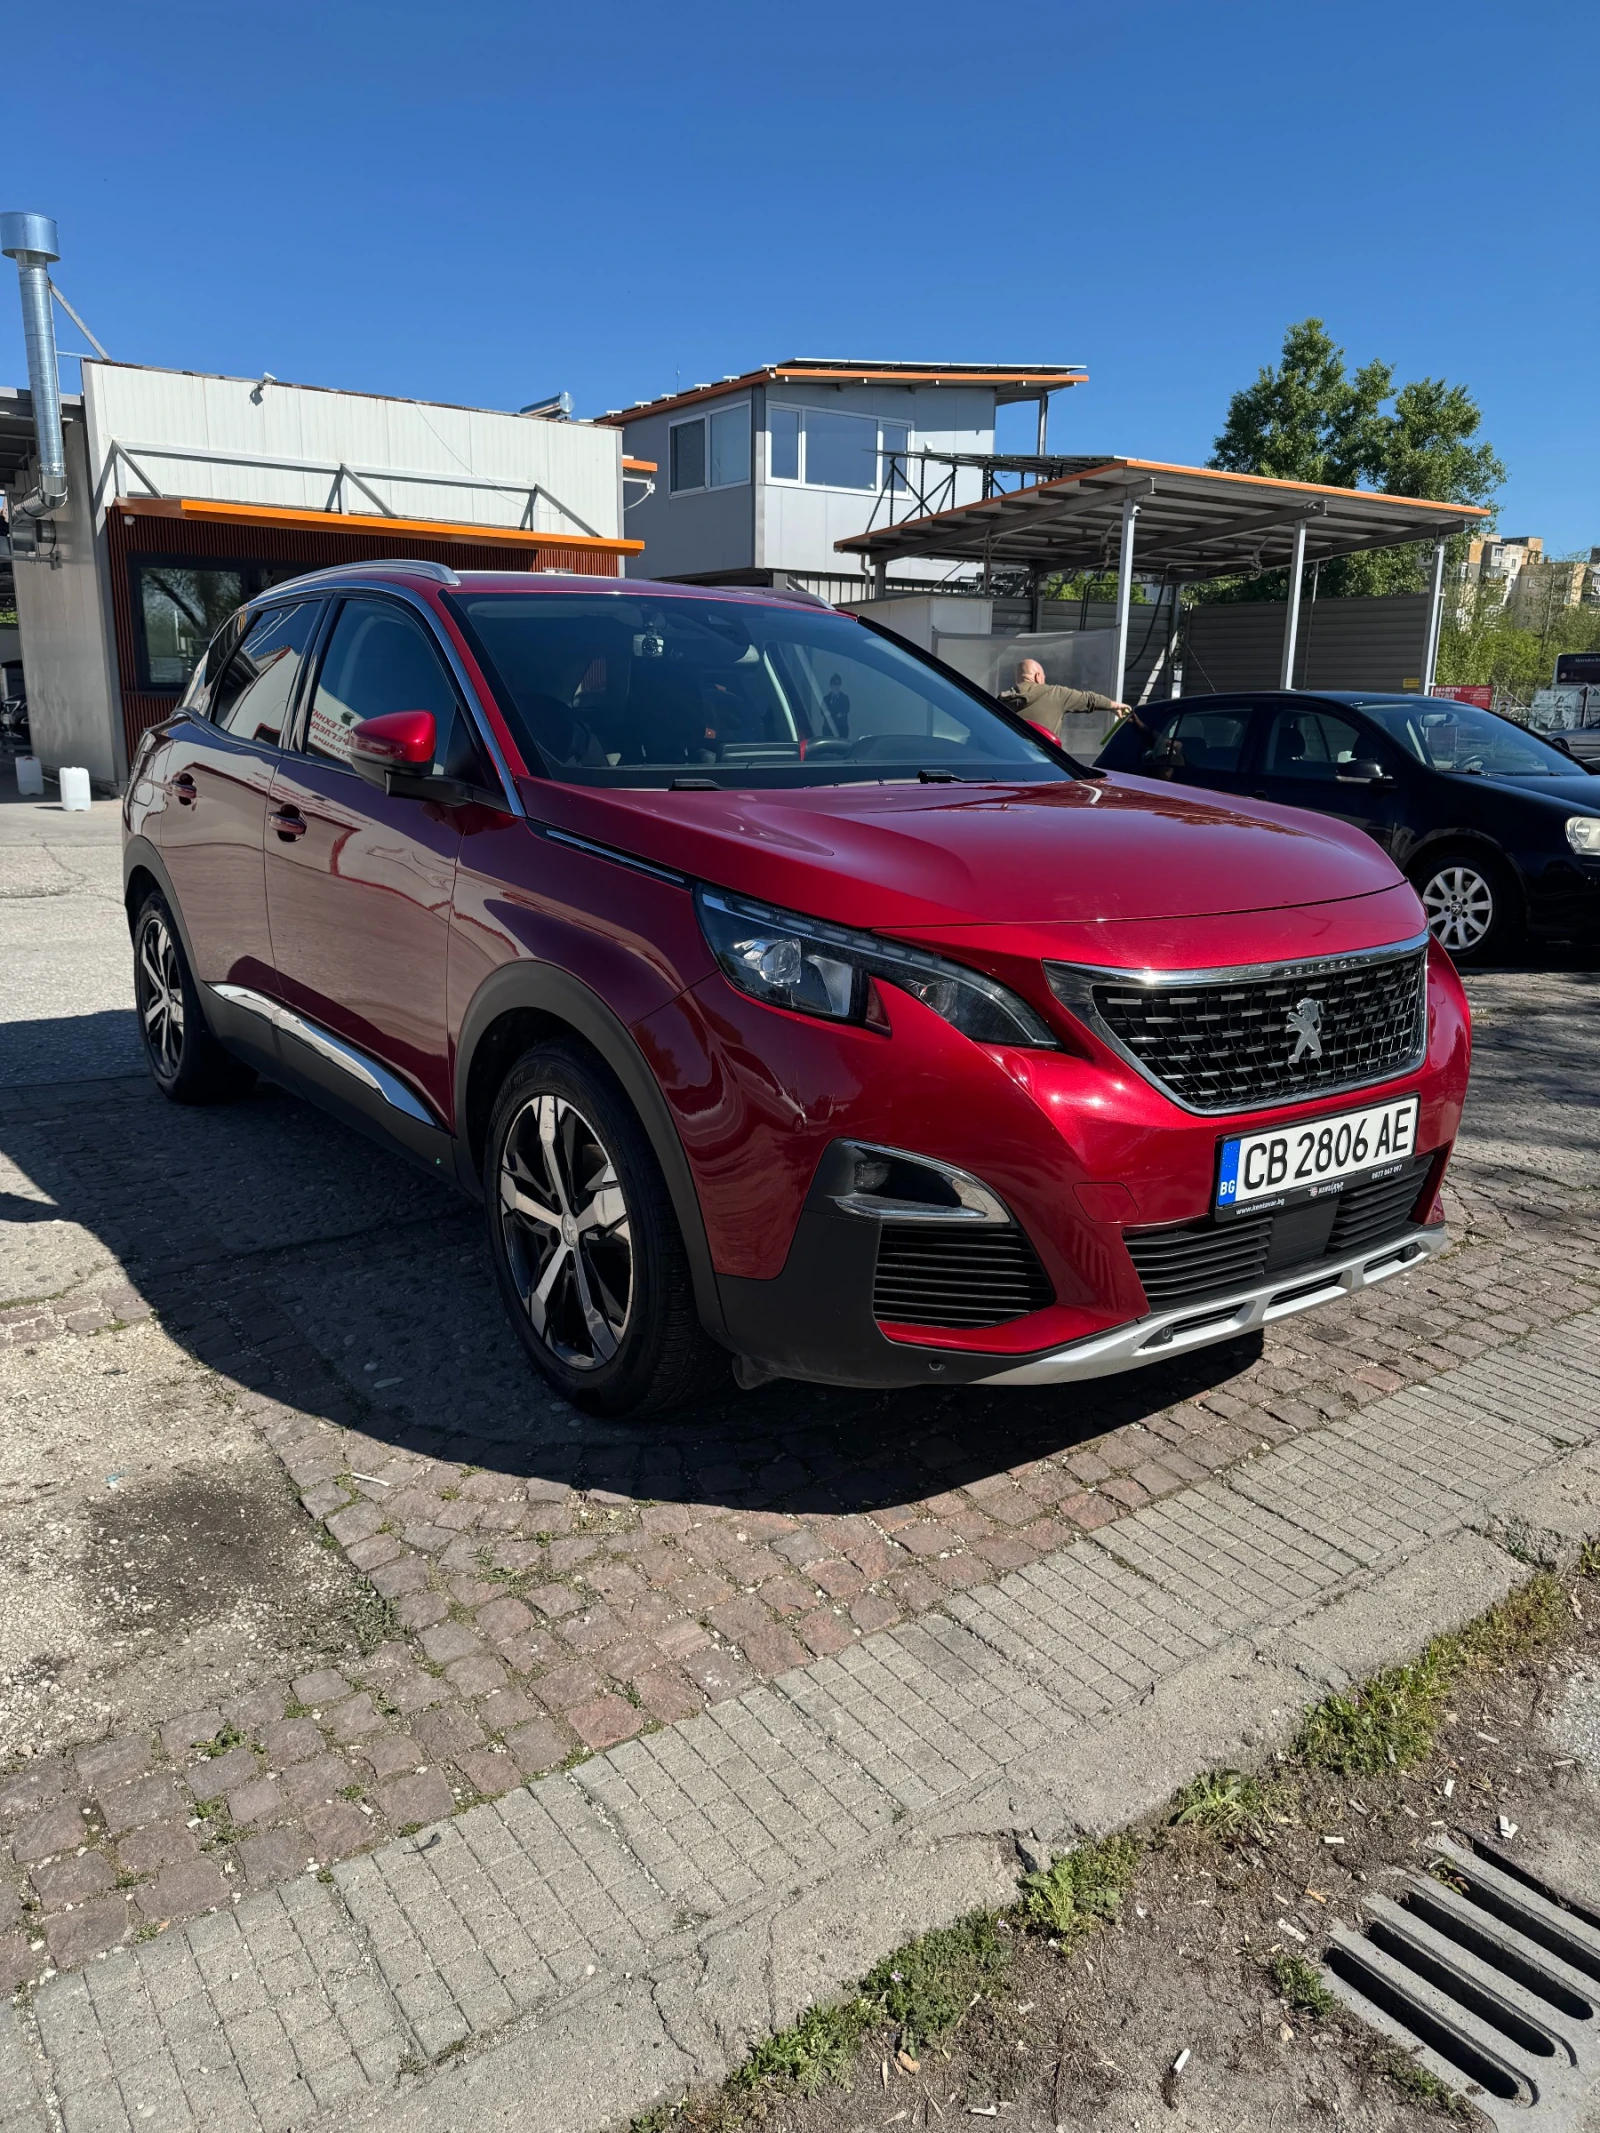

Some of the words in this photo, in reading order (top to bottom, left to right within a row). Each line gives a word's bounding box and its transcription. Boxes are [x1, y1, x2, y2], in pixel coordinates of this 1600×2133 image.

[1284, 958, 1356, 978] PEUGEOT
[1244, 1137, 1288, 1190] CB
[1294, 1118, 1369, 1179] 2806
[1374, 1106, 1412, 1158] AE
[1220, 1179, 1236, 1196] BG
